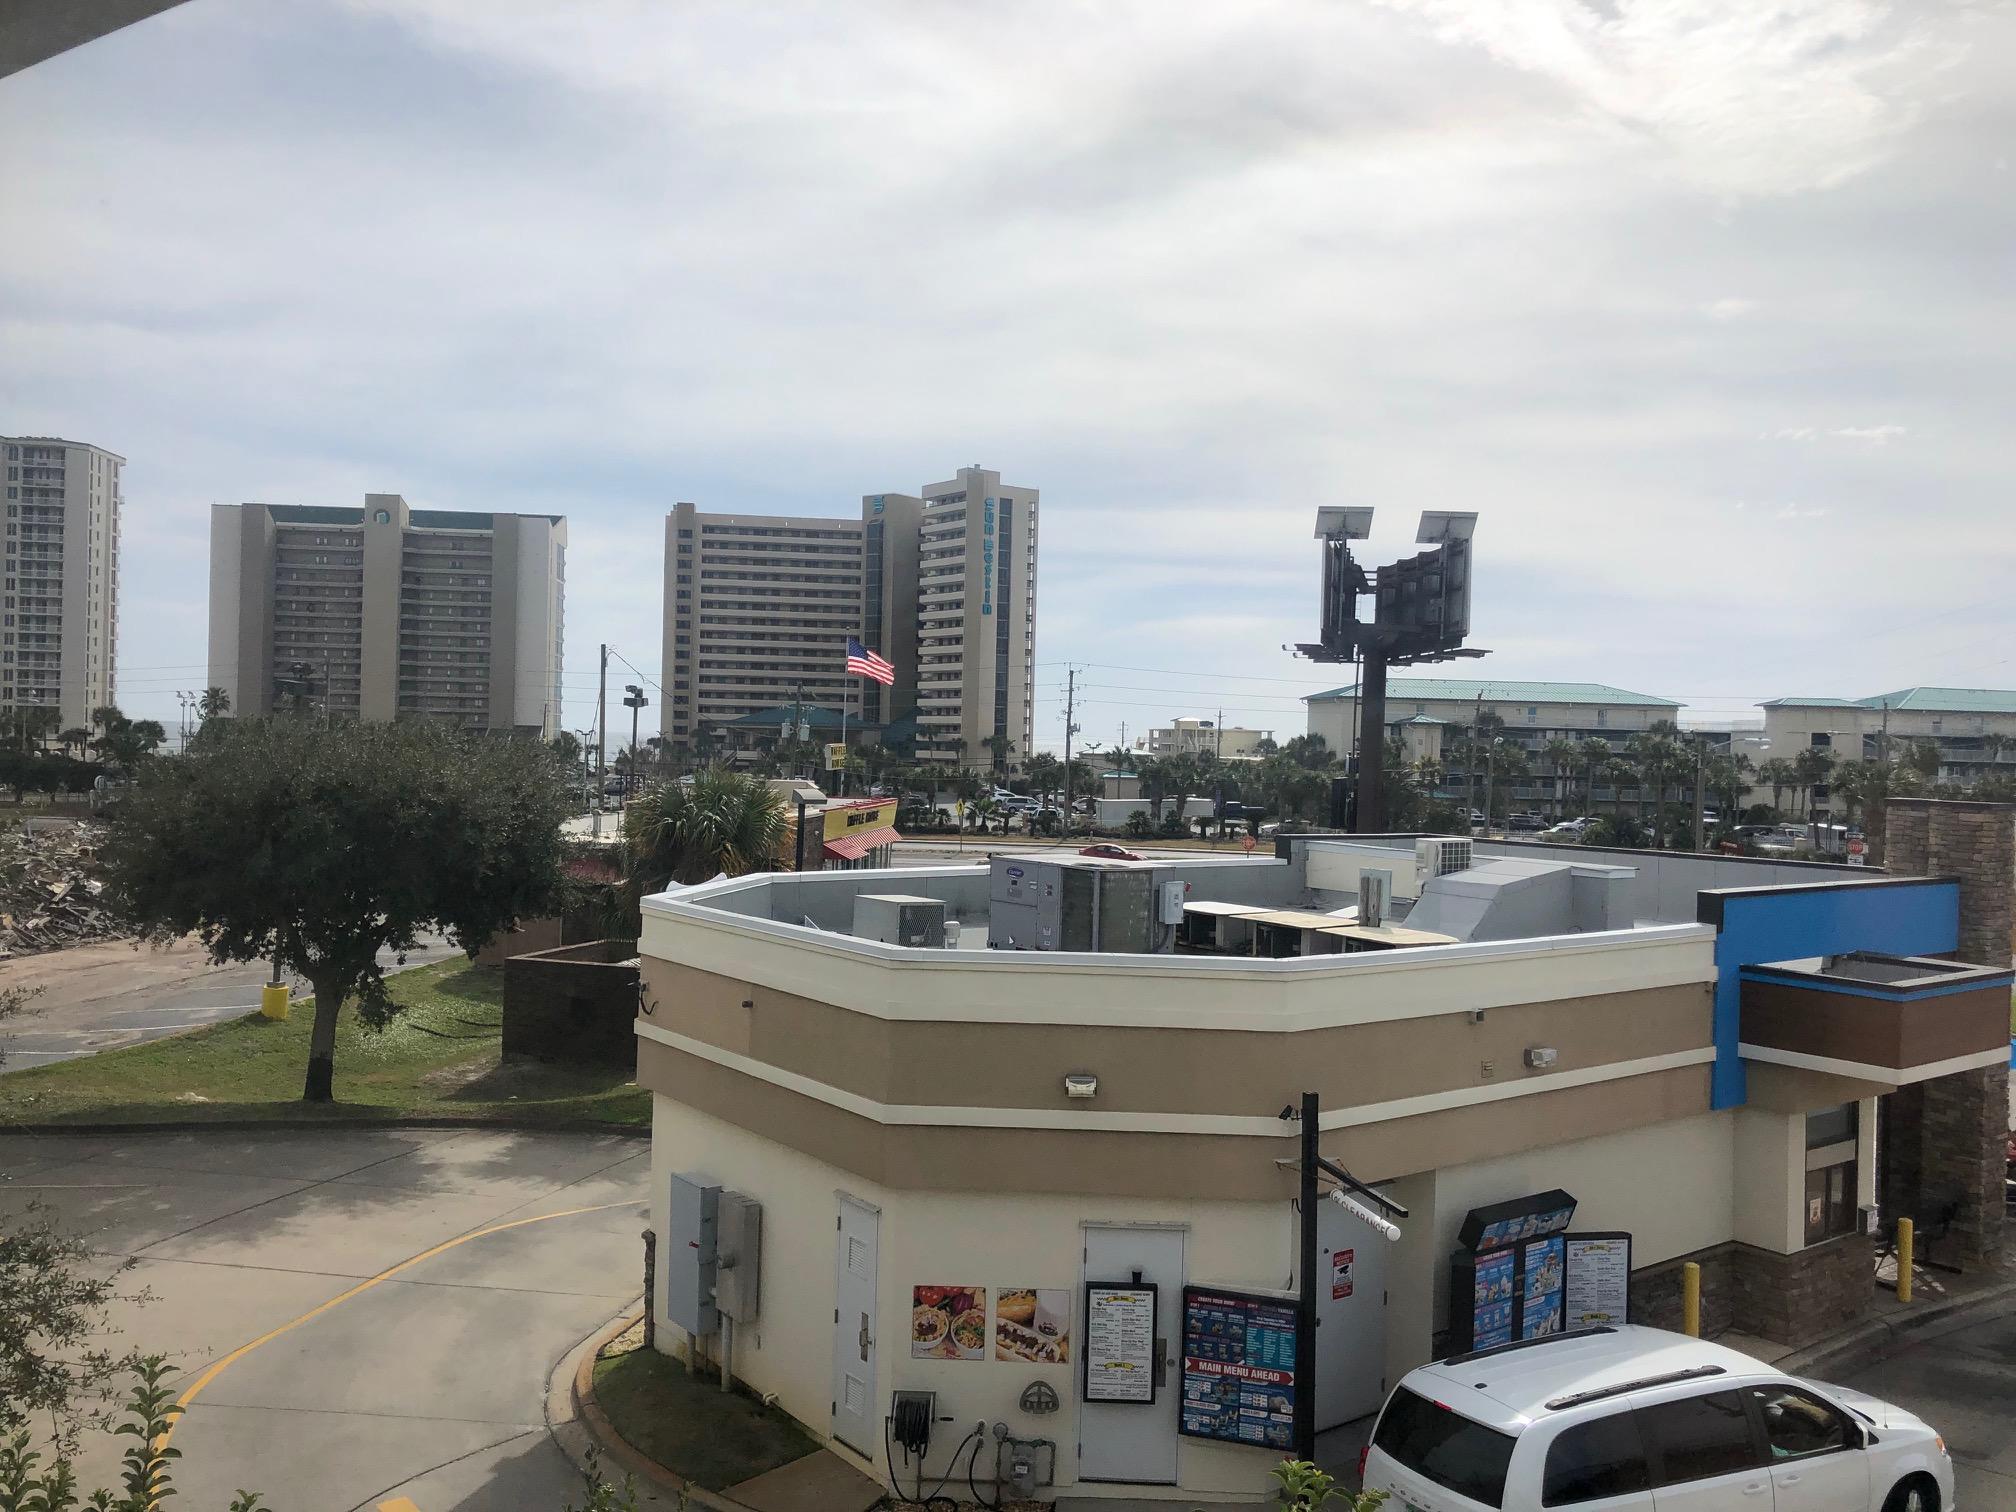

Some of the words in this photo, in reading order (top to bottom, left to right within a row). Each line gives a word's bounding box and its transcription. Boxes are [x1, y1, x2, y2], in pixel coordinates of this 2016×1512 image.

[1341, 1200, 1386, 1234] CLEARANCE
[1198, 1361, 1222, 1373] MAIN
[1223, 1365, 1249, 1378] MENU
[1250, 1369, 1280, 1382] AHEAD
